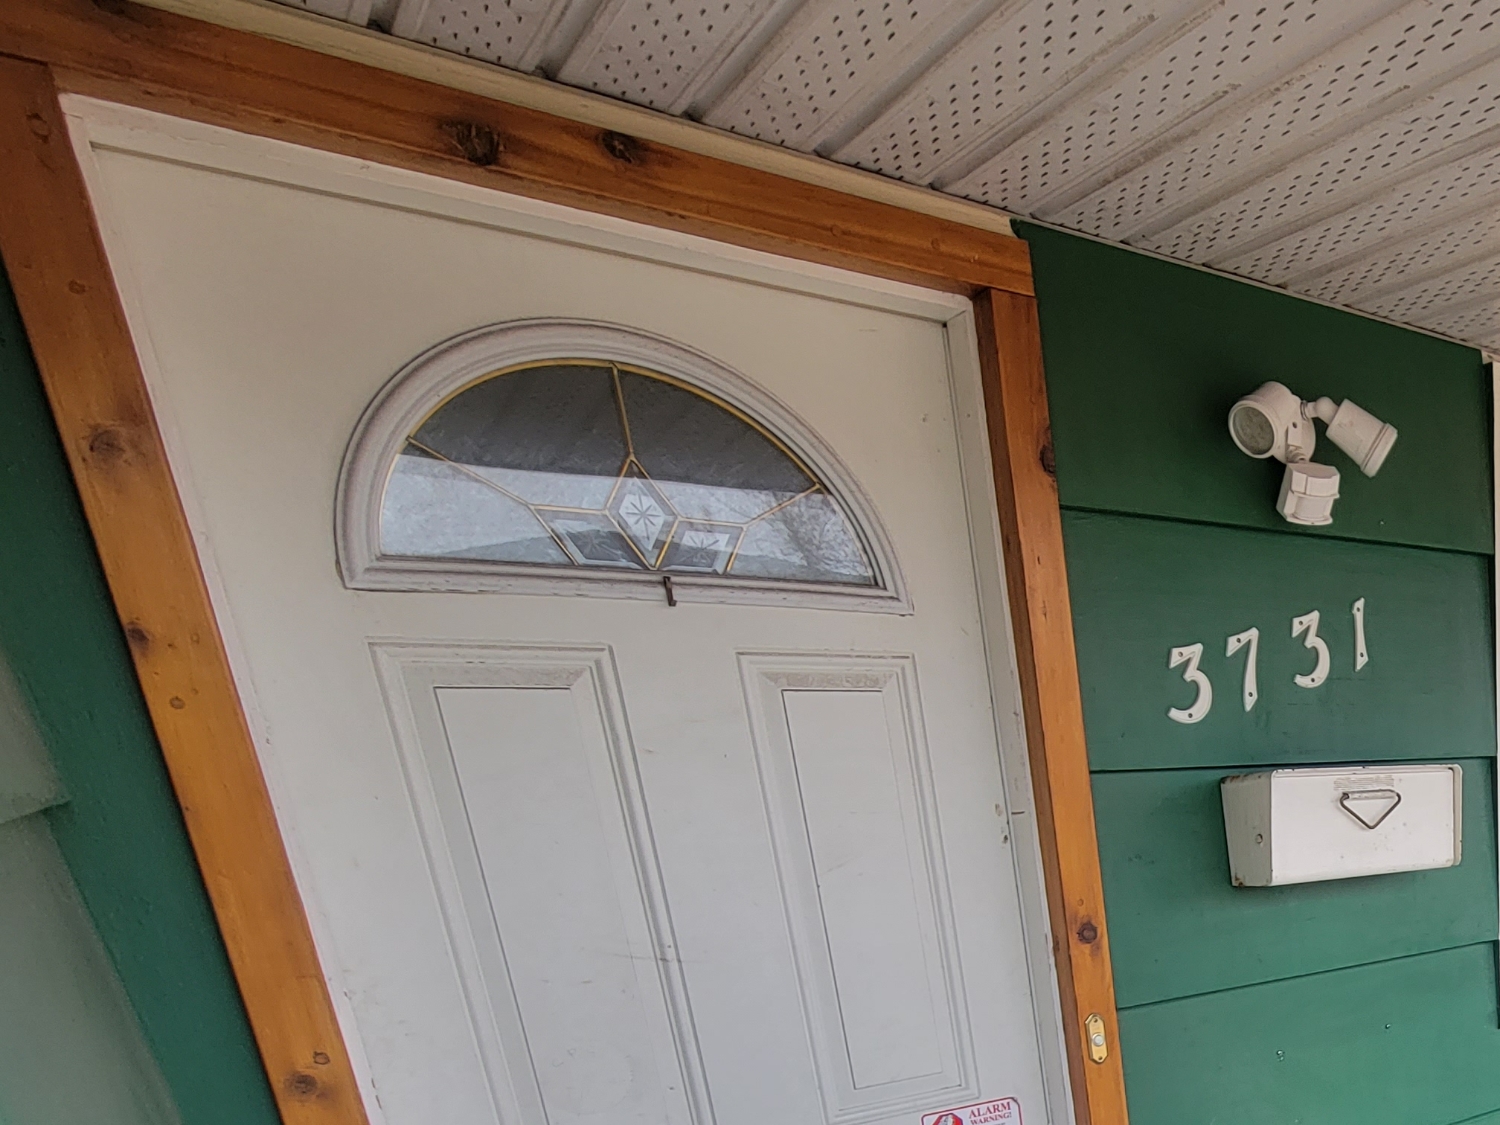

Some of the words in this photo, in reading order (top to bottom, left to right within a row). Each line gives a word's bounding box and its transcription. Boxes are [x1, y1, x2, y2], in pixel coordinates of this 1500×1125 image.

[1167, 597, 1369, 724] 3731
[968, 1101, 1012, 1119] ALARM
[970, 1111, 1012, 1125] WARNING!
